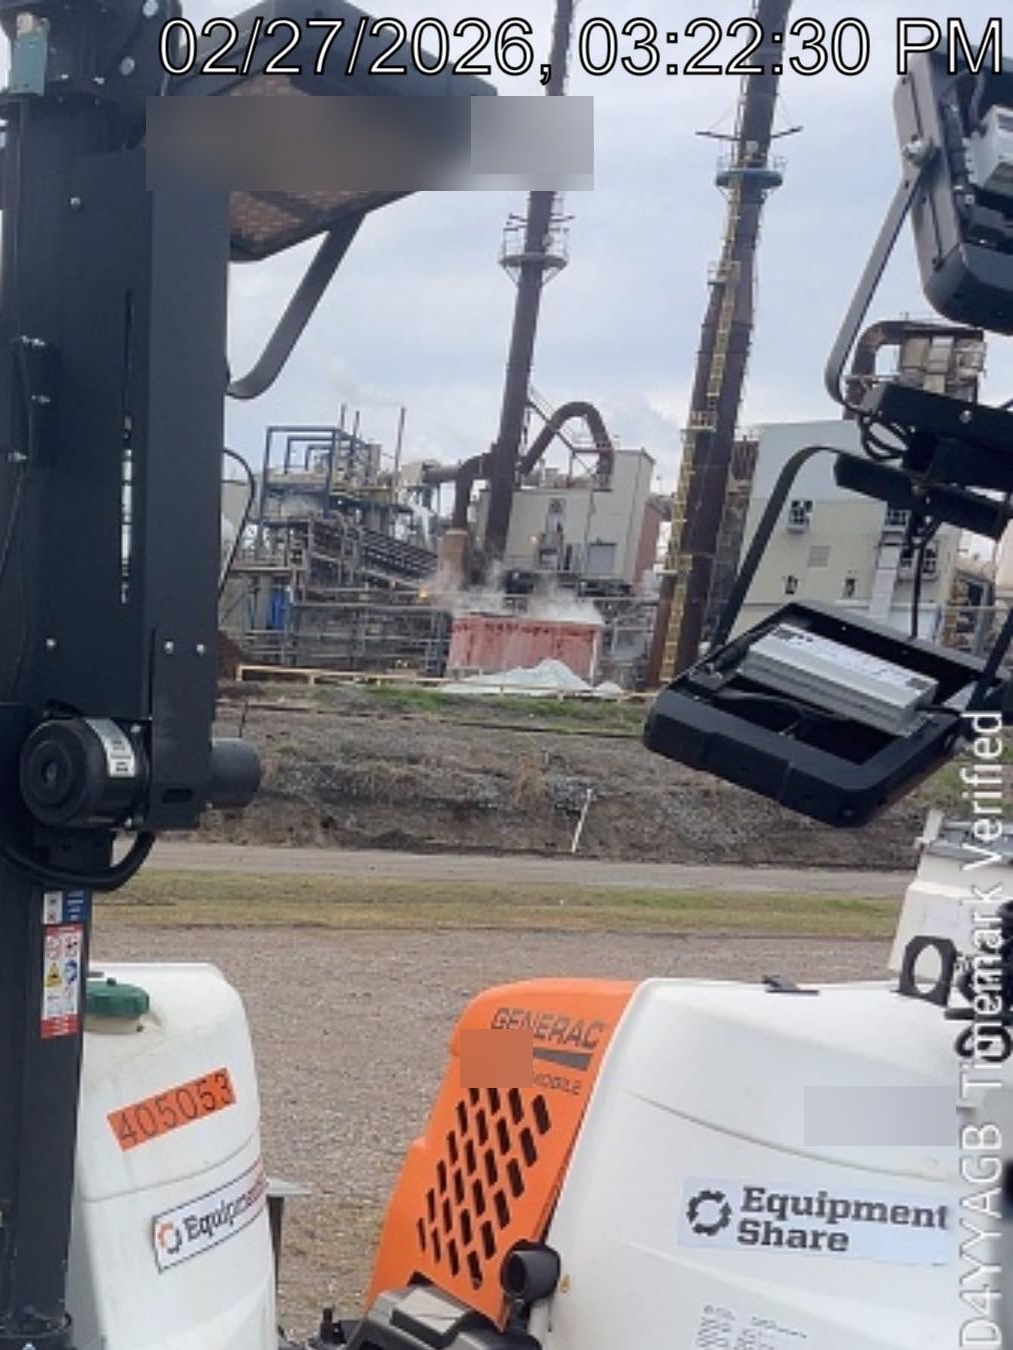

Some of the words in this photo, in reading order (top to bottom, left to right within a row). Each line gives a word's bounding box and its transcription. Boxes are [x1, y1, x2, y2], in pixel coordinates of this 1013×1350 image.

[491, 1007, 607, 1050] GENERAC
[118, 1072, 233, 1143] 405053
[740, 1184, 949, 1230] Equipment
[738, 1216, 849, 1252] Share
